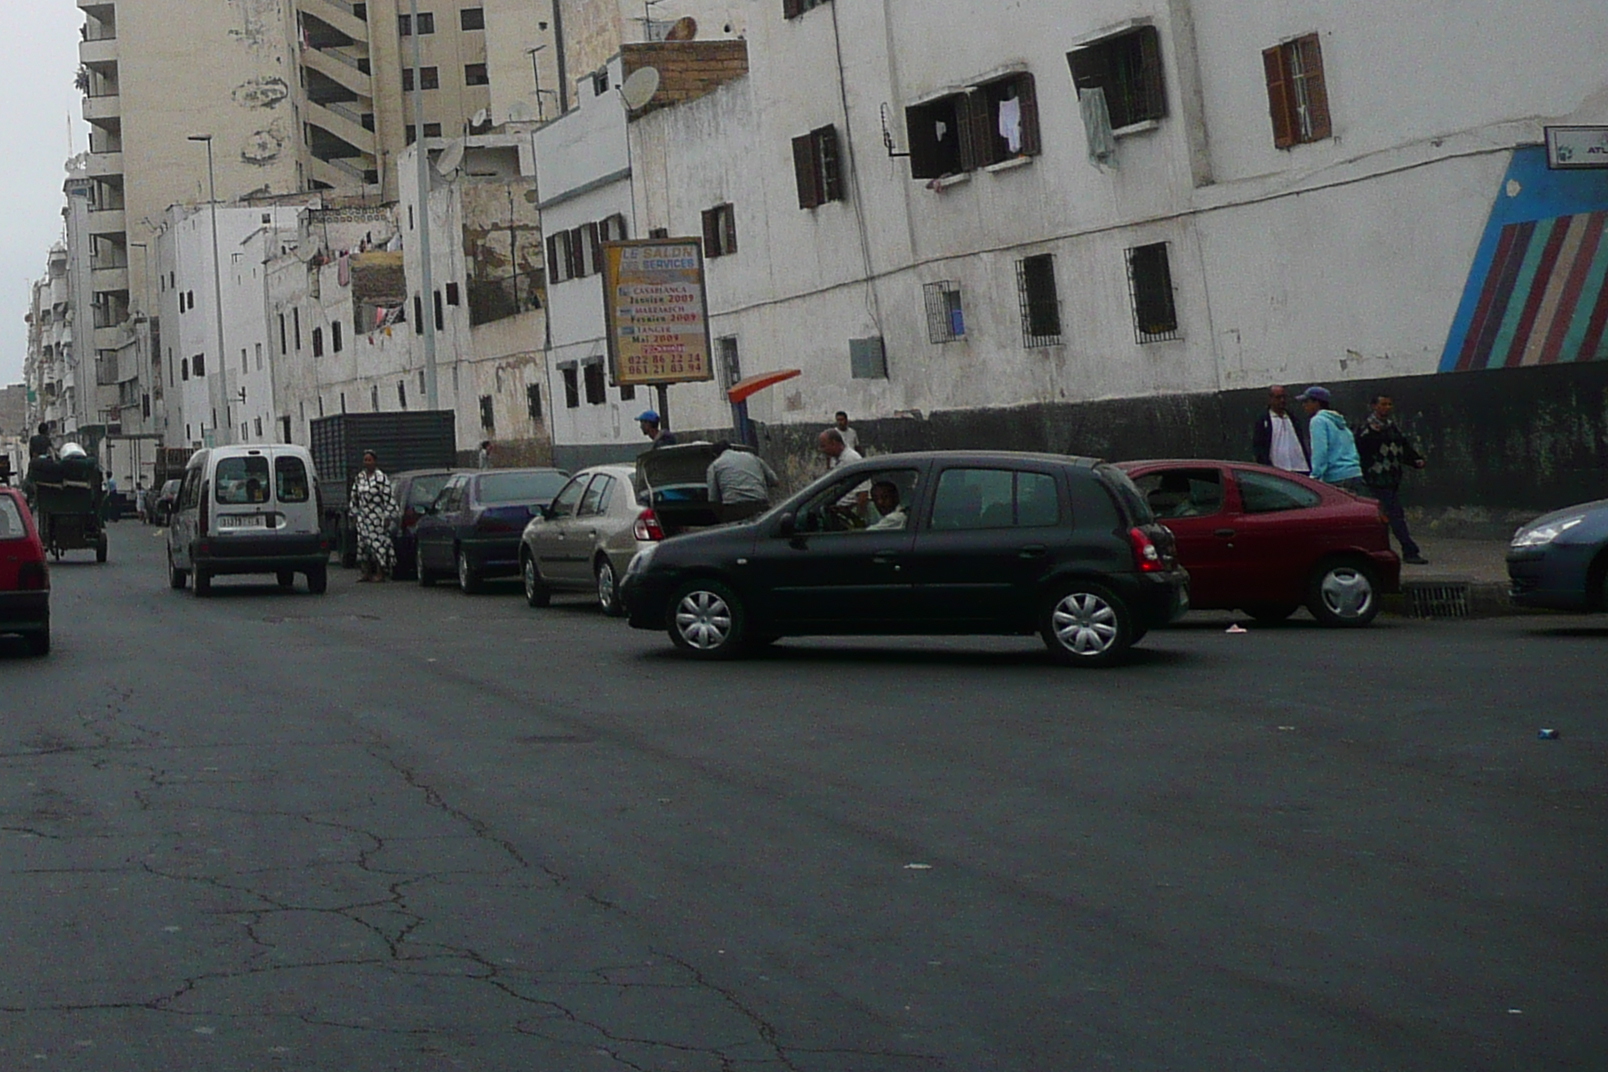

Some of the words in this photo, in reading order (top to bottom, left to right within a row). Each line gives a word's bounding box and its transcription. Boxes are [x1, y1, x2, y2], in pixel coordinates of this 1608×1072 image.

[623, 247, 639, 259] LE
[643, 246, 693, 259] SALON
[643, 258, 695, 269] SERVICES
[667, 294, 695, 303] 2009
[670, 312, 697, 322] 2009
[653, 334, 679, 342] 2009
